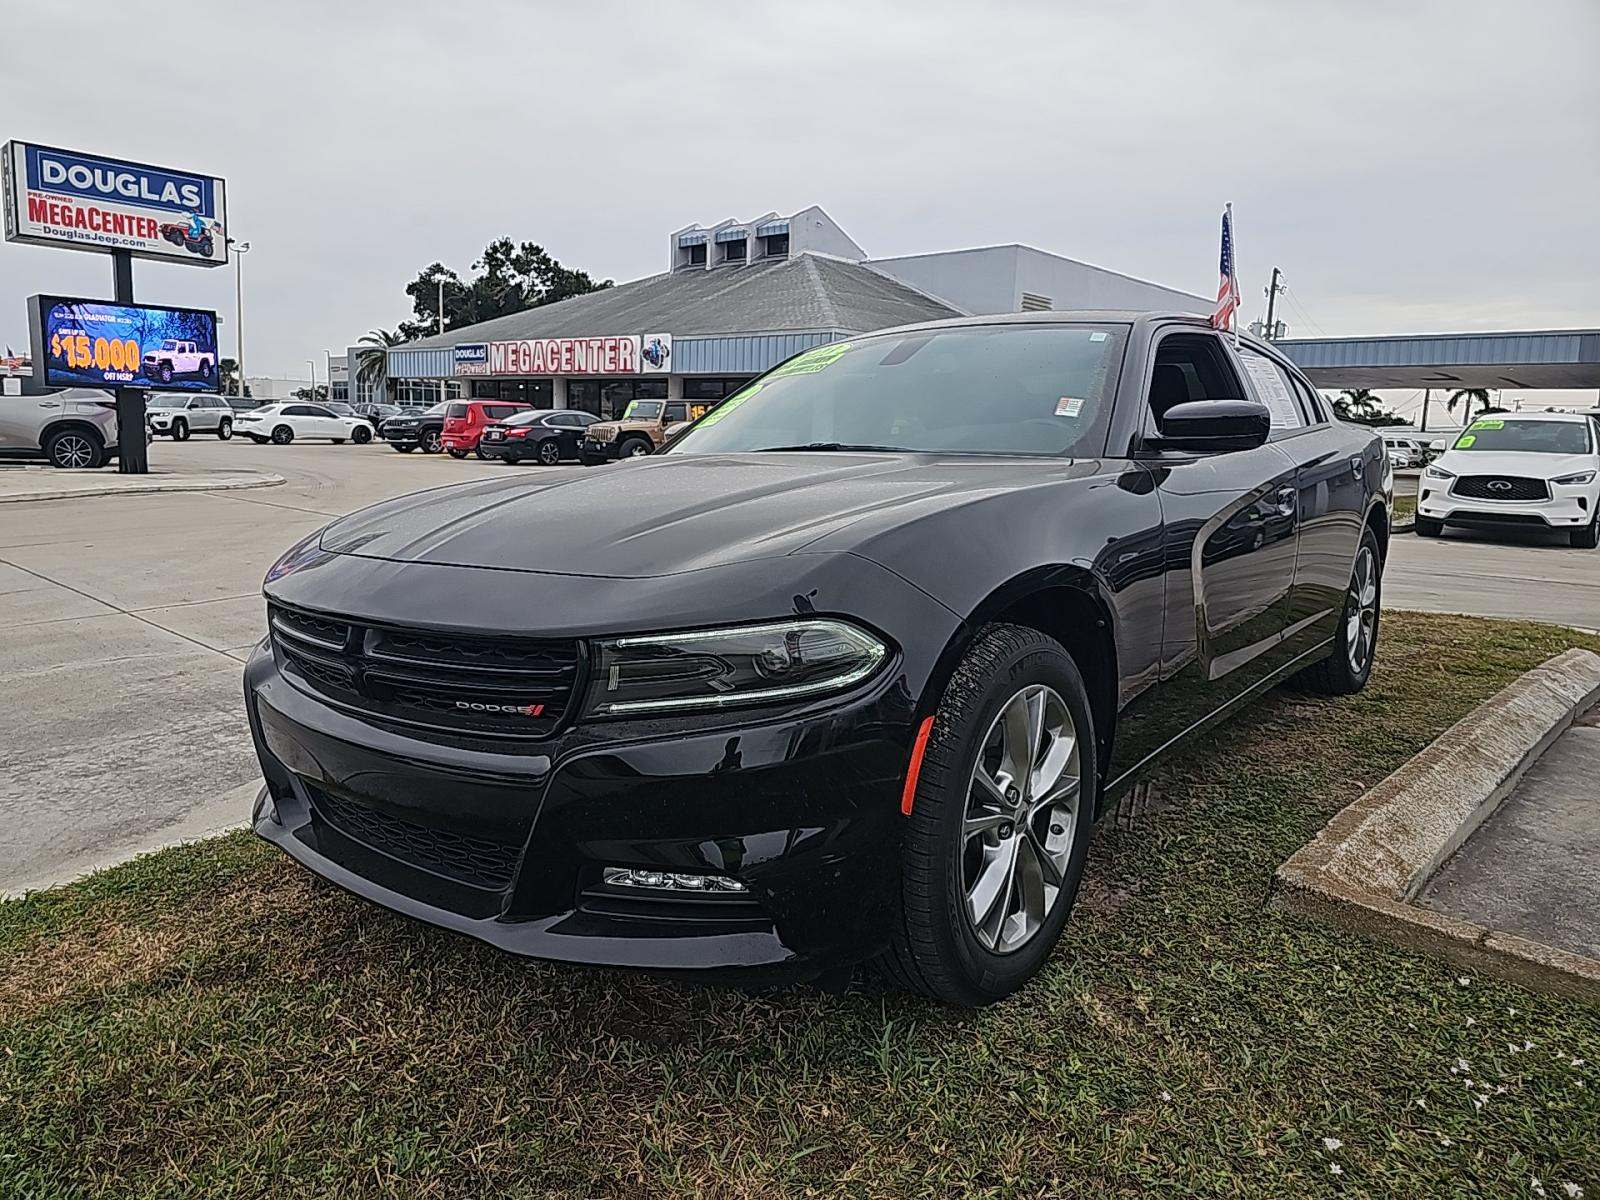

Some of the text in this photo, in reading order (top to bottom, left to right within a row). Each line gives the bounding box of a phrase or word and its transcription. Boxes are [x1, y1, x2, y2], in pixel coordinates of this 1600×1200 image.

[42, 160, 201, 208] DOUGLAS
[27, 192, 73, 203] PRE-OWNED
[28, 198, 159, 240] MEGACENTER
[43, 225, 146, 248] DouglasJeep.com
[455, 348, 485, 359] DOUGLAS
[491, 338, 634, 374] MEGACENTER
[456, 701, 532, 715] DODGE
